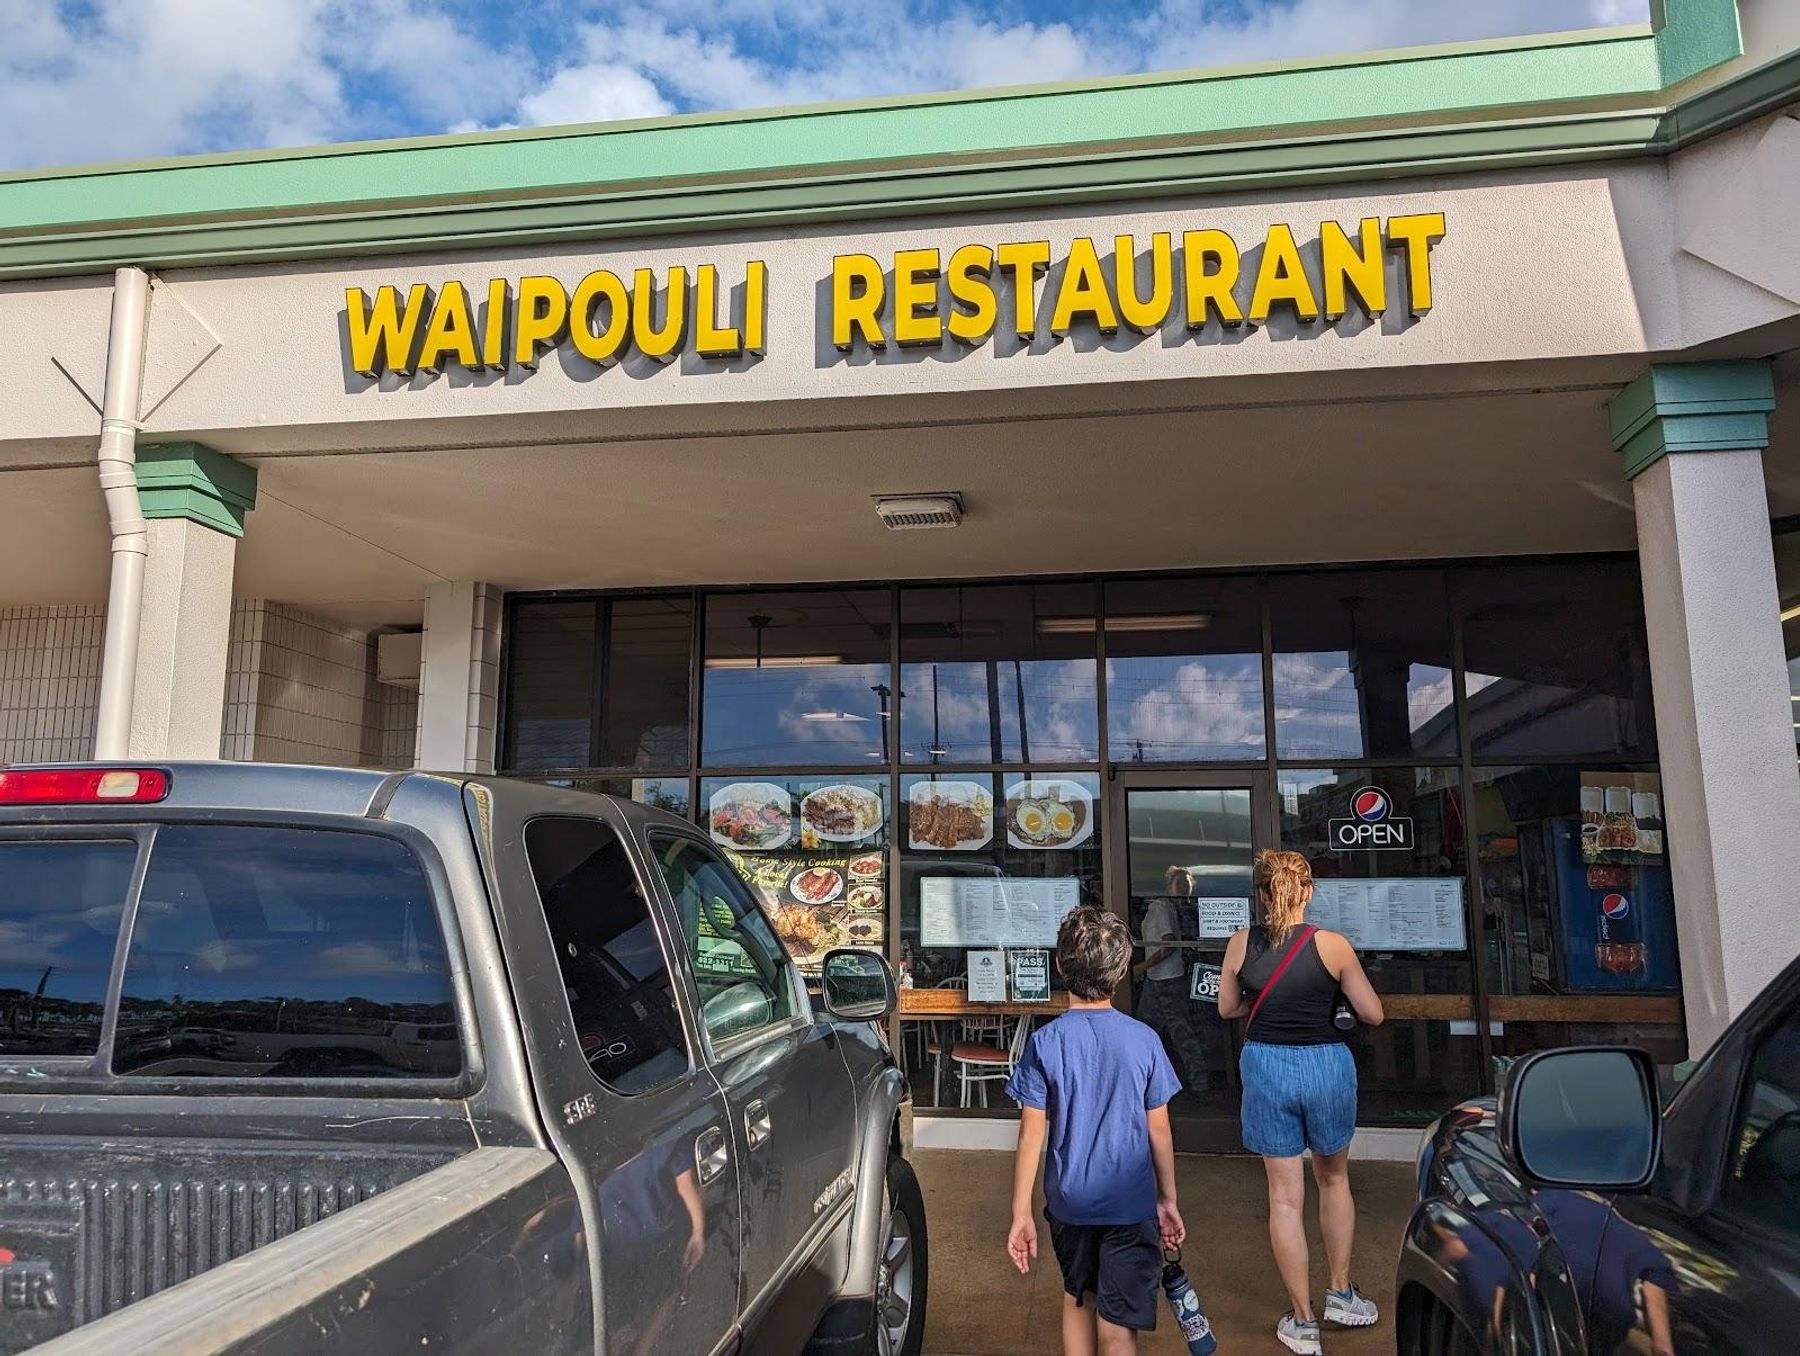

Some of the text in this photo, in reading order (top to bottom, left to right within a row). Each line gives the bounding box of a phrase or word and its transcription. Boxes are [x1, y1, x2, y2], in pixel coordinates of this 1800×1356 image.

[345, 212, 1446, 377] WAIPOULI RESTAURANT
[1339, 823, 1404, 844] OPEN
[782, 858, 806, 869] Style
[807, 857, 848, 867] Cooking
[1017, 957, 1043, 967] PASS
[1197, 983, 1219, 995] OP
